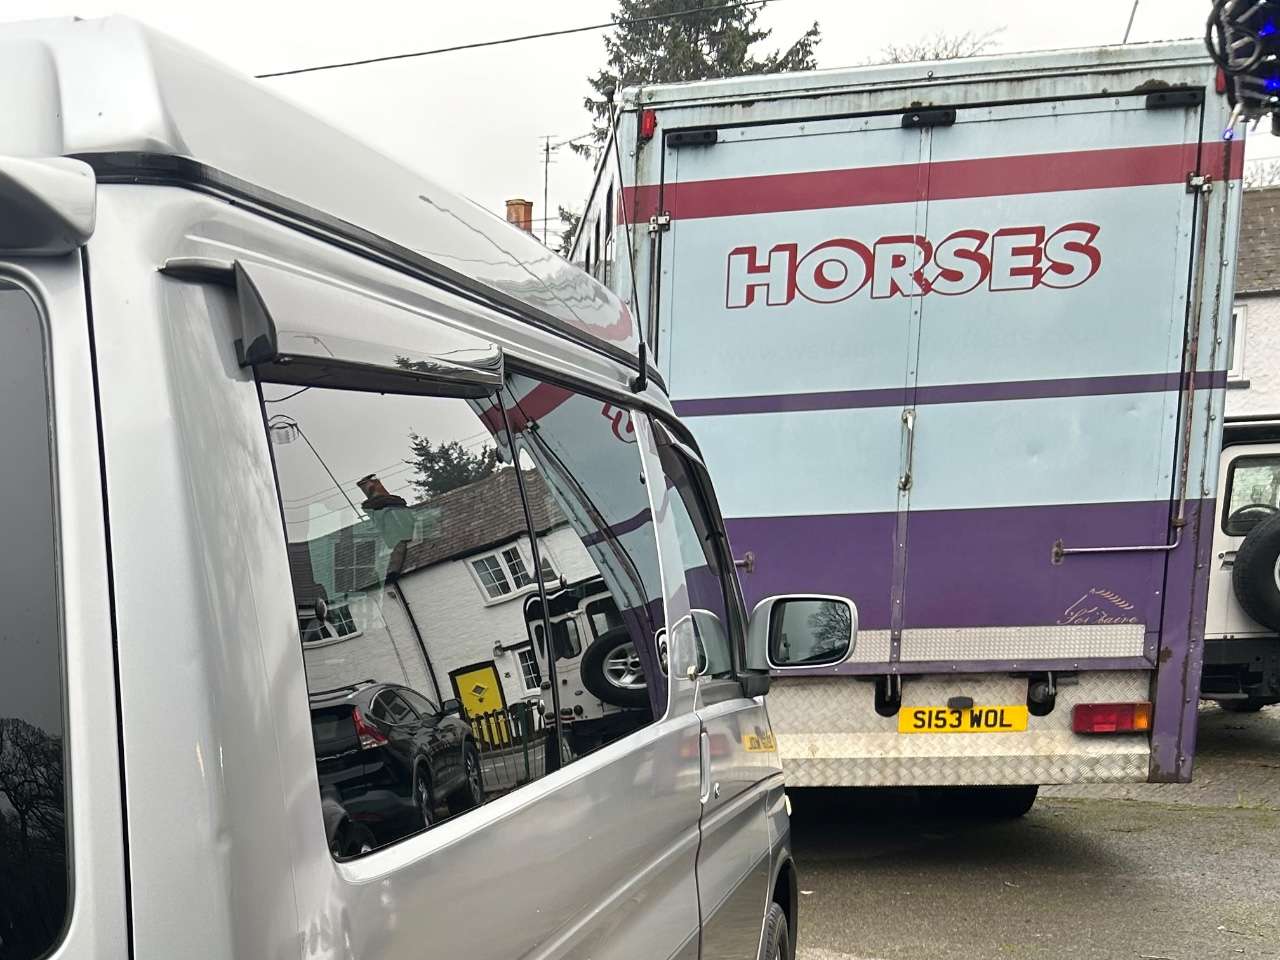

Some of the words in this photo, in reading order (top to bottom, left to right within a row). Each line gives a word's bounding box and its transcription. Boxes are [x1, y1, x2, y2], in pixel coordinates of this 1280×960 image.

[726, 221, 1102, 309] HORSES
[913, 710, 962, 728] S153
[970, 709, 1012, 727] WOL
